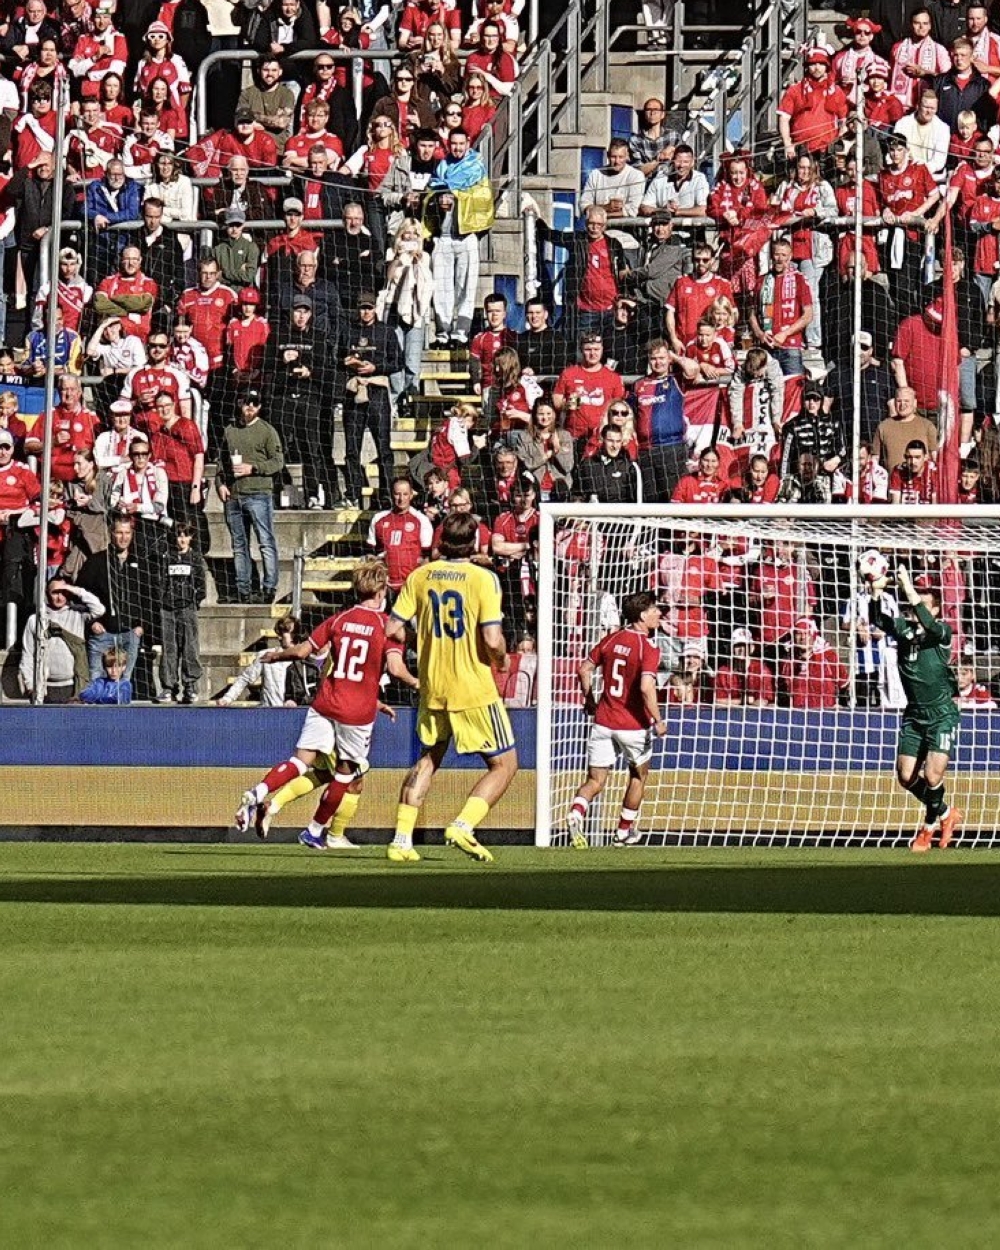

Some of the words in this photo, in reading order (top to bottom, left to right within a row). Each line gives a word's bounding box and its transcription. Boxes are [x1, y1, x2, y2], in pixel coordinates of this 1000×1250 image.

[427, 588, 465, 639] 13
[333, 636, 369, 682] 12
[610, 658, 627, 698] 5
